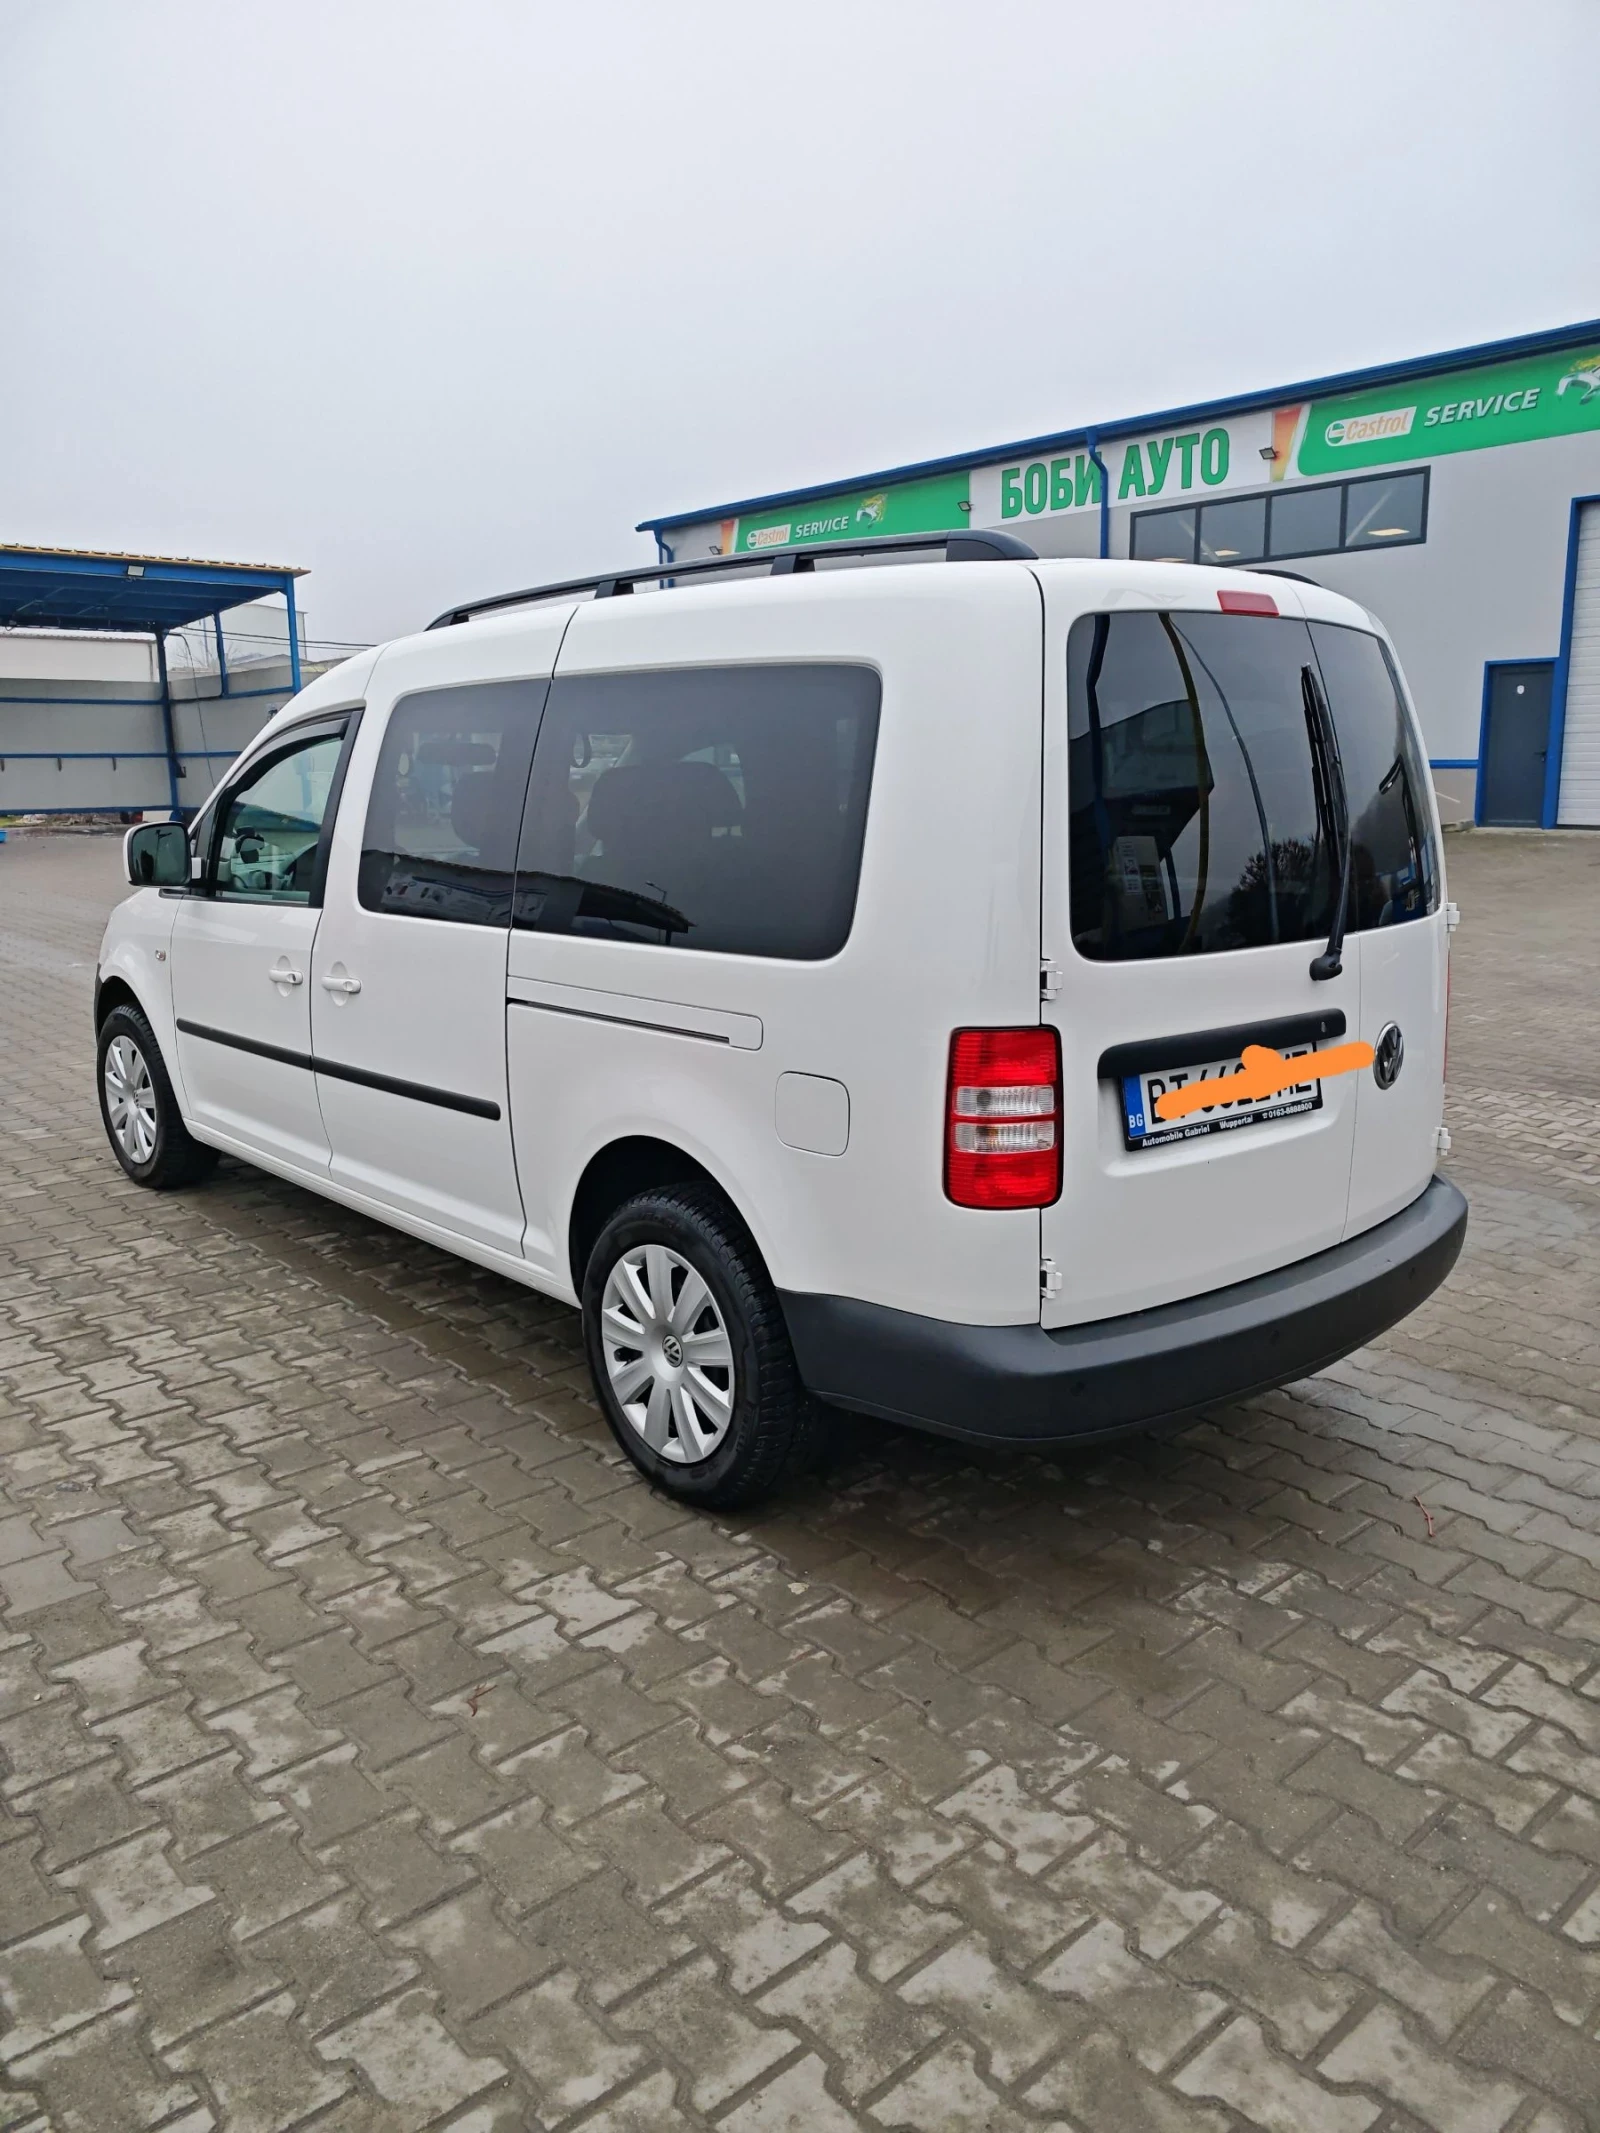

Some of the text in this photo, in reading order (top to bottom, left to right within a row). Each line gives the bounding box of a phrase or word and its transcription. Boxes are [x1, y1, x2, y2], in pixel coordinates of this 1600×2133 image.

[1346, 387, 1541, 440] Castrol SERVICE
[1001, 427, 1230, 519] БОБИ АУТО
[757, 515, 849, 546] Castrol SERVICE
[1128, 1113, 1144, 1129] BG
[1142, 1131, 1184, 1148] Automobile
[1184, 1124, 1211, 1138] Gabriel
[1219, 1114, 1254, 1130] Wuppertal
